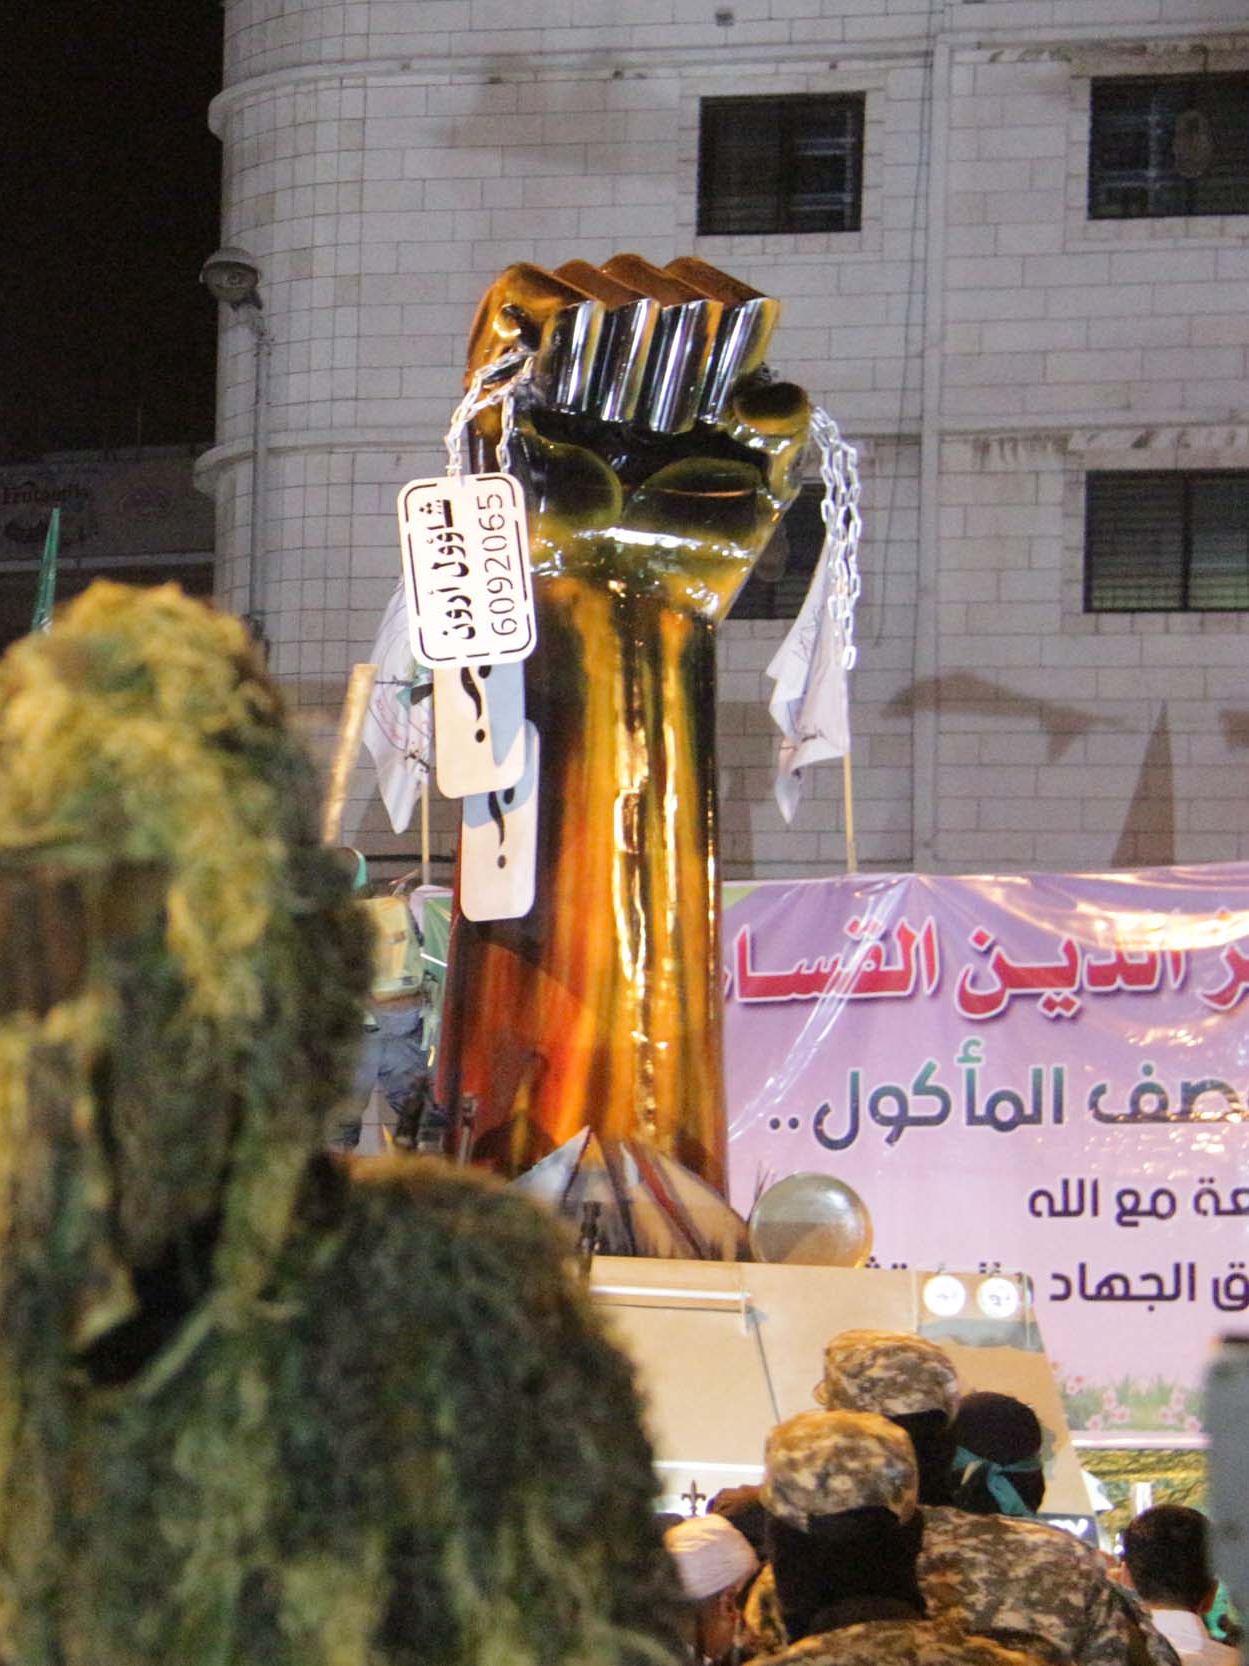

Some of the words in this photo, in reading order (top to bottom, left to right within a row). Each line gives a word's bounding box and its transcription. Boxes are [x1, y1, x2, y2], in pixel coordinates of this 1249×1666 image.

[476, 493, 519, 637] 6092065
[724, 916, 940, 1002] القسا
[1088, 1062, 1249, 1125] صف
[1028, 1177, 1099, 1218] الله
[1115, 1187, 1177, 1228] مع
[1049, 1261, 1196, 1312] الجهاد
